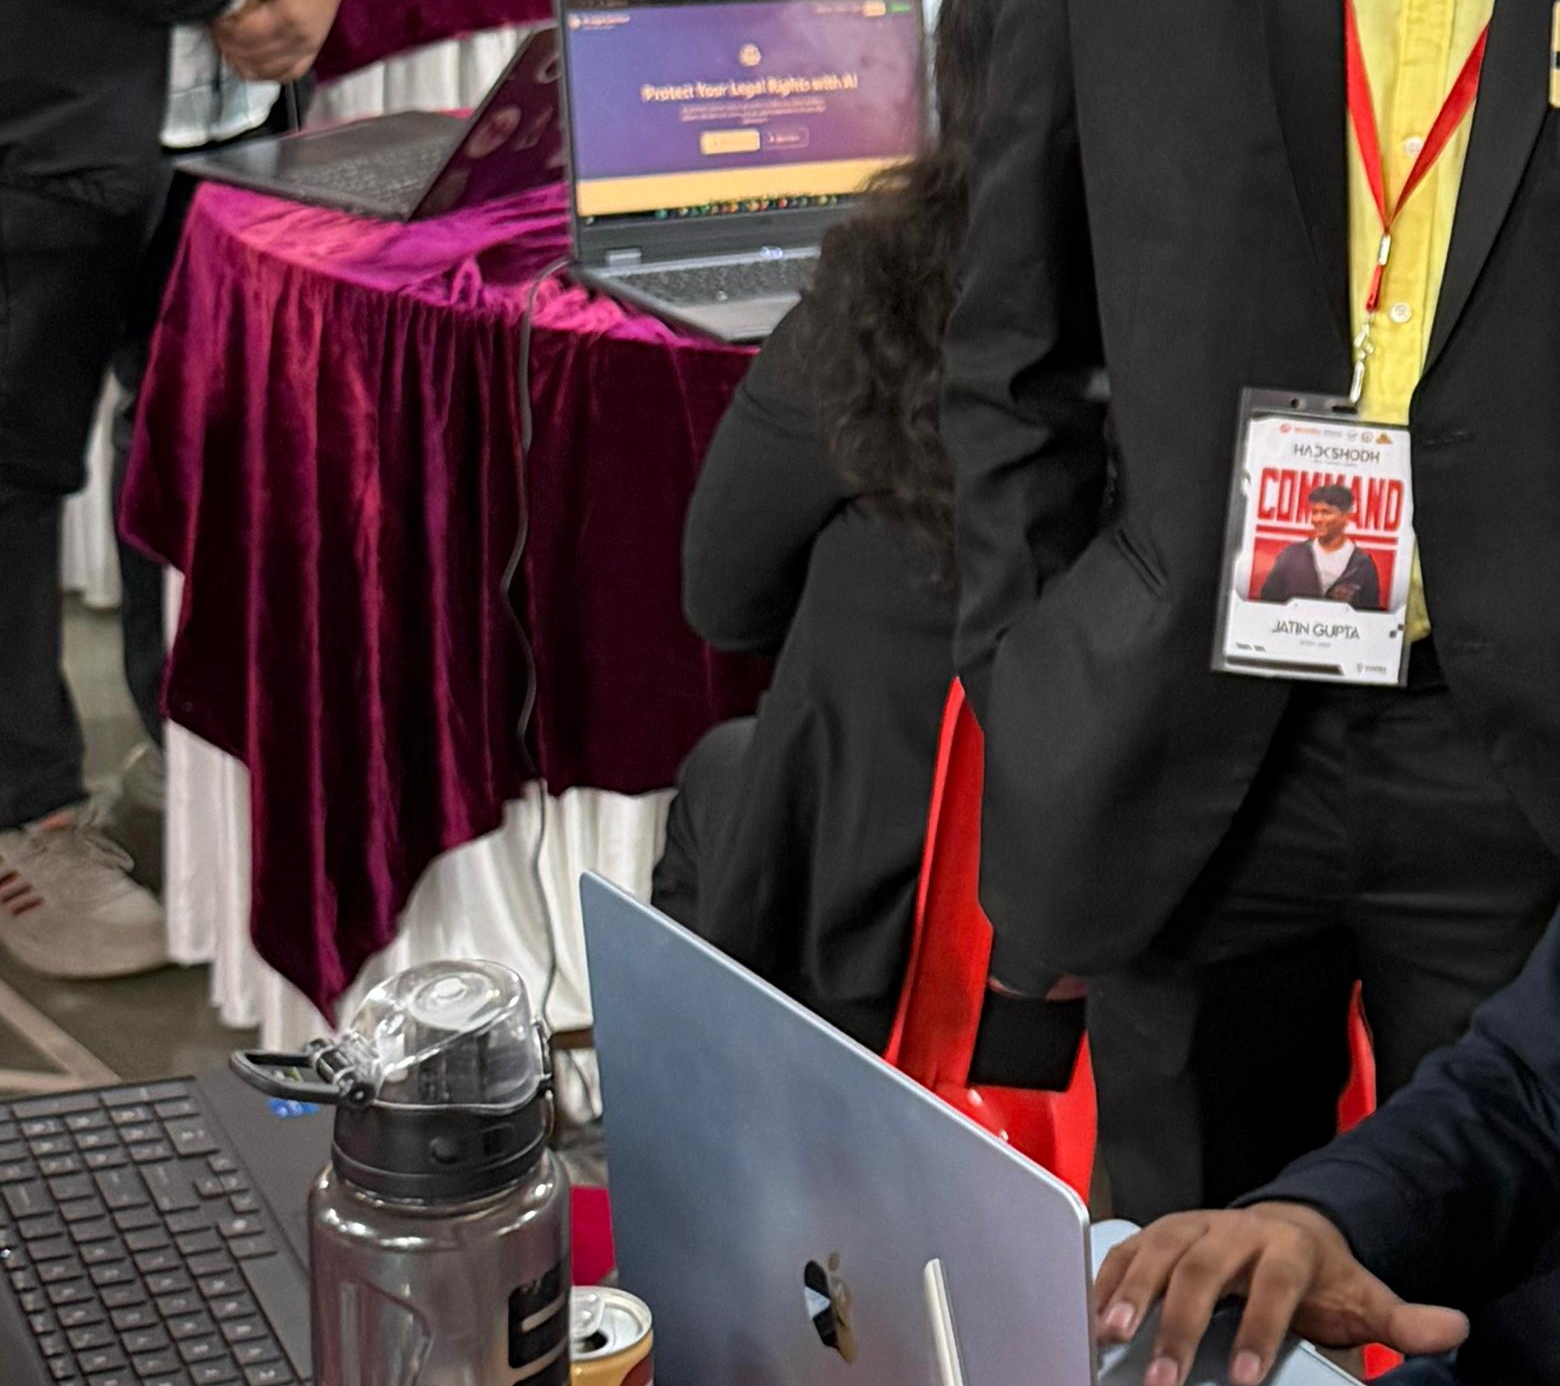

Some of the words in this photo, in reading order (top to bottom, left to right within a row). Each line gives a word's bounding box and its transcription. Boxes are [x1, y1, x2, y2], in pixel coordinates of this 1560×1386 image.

[641, 83, 694, 103] Protect
[695, 81, 727, 99] Your
[729, 79, 767, 99] Legal
[767, 76, 811, 97] Rights
[812, 74, 842, 92] with
[1270, 619, 1311, 635] JATIN
[1312, 622, 1360, 640] GUPTA
